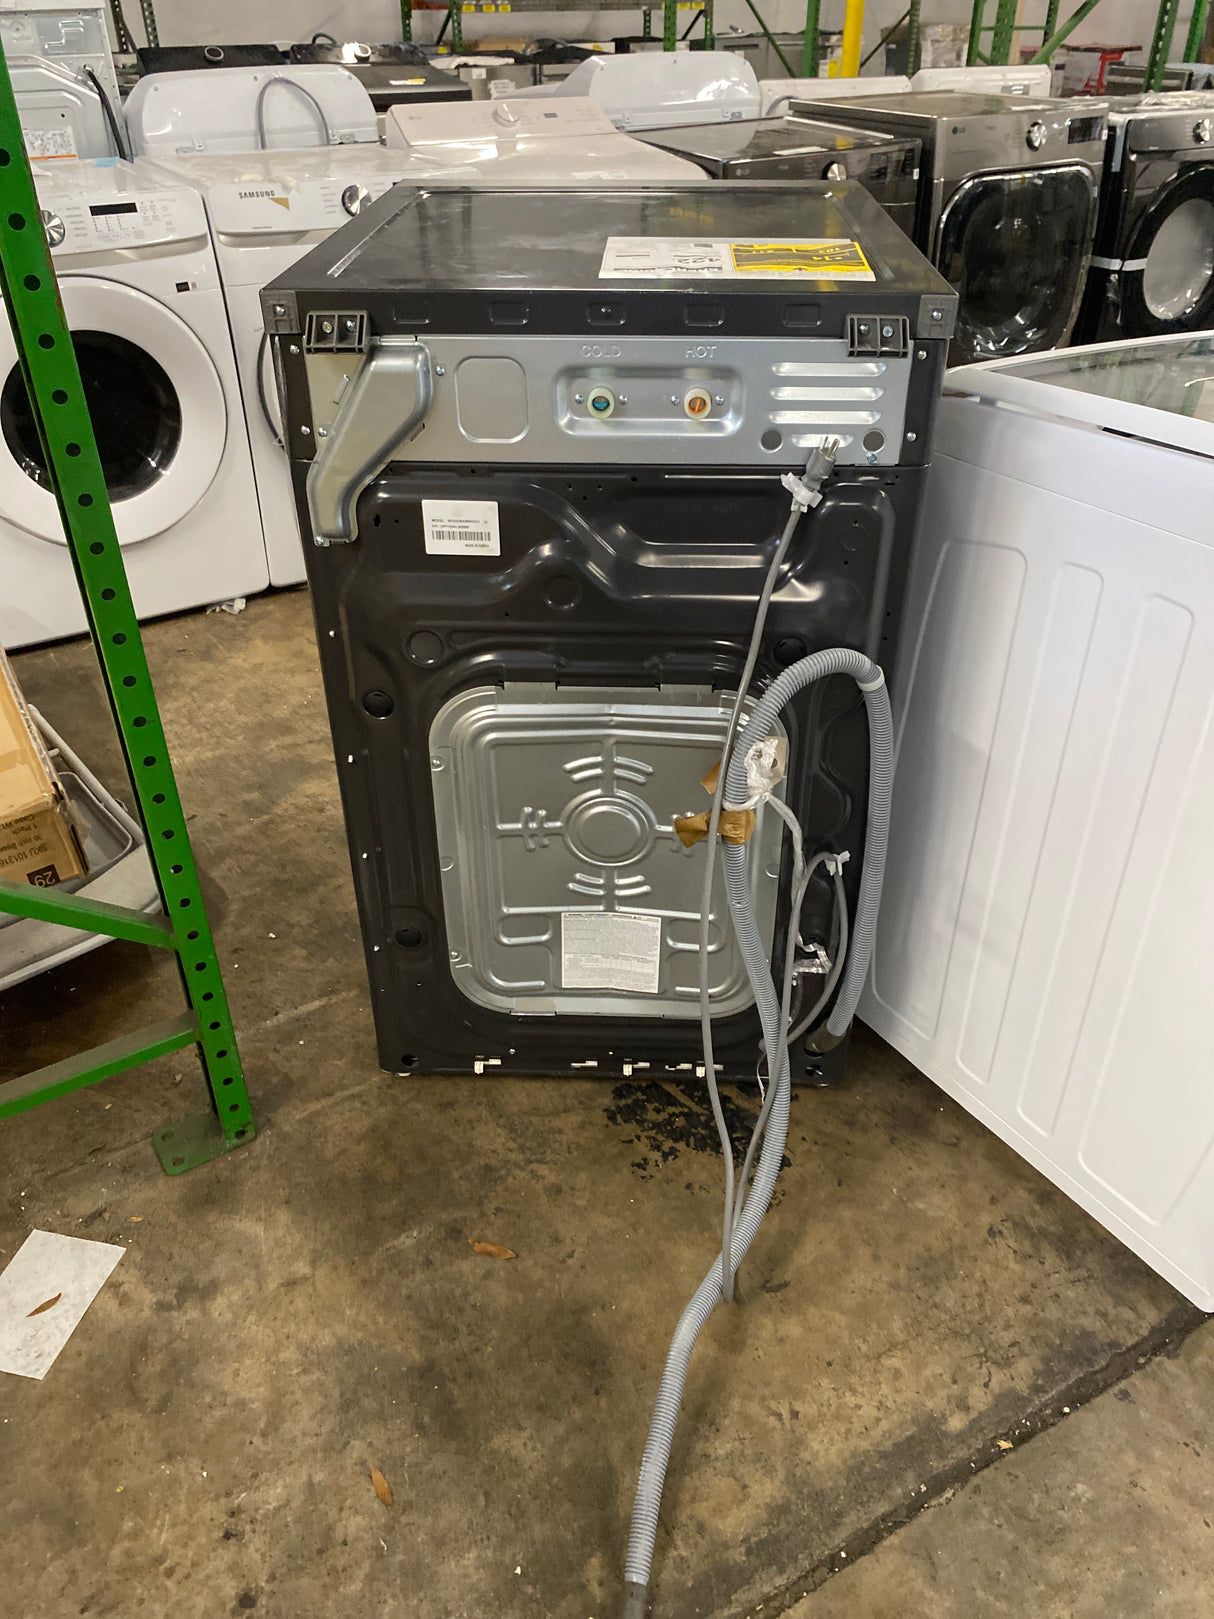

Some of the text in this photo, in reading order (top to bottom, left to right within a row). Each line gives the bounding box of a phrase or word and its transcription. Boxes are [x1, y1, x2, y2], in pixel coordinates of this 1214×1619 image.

[238, 190, 276, 199] SAMSUNG
[581, 344, 622, 358] COLD
[685, 345, 717, 359] HOT
[14, 814, 35, 824] Case
[12, 825, 32, 836] Pack
[29, 844, 48, 857] SKU
[34, 870, 56, 887] 29
